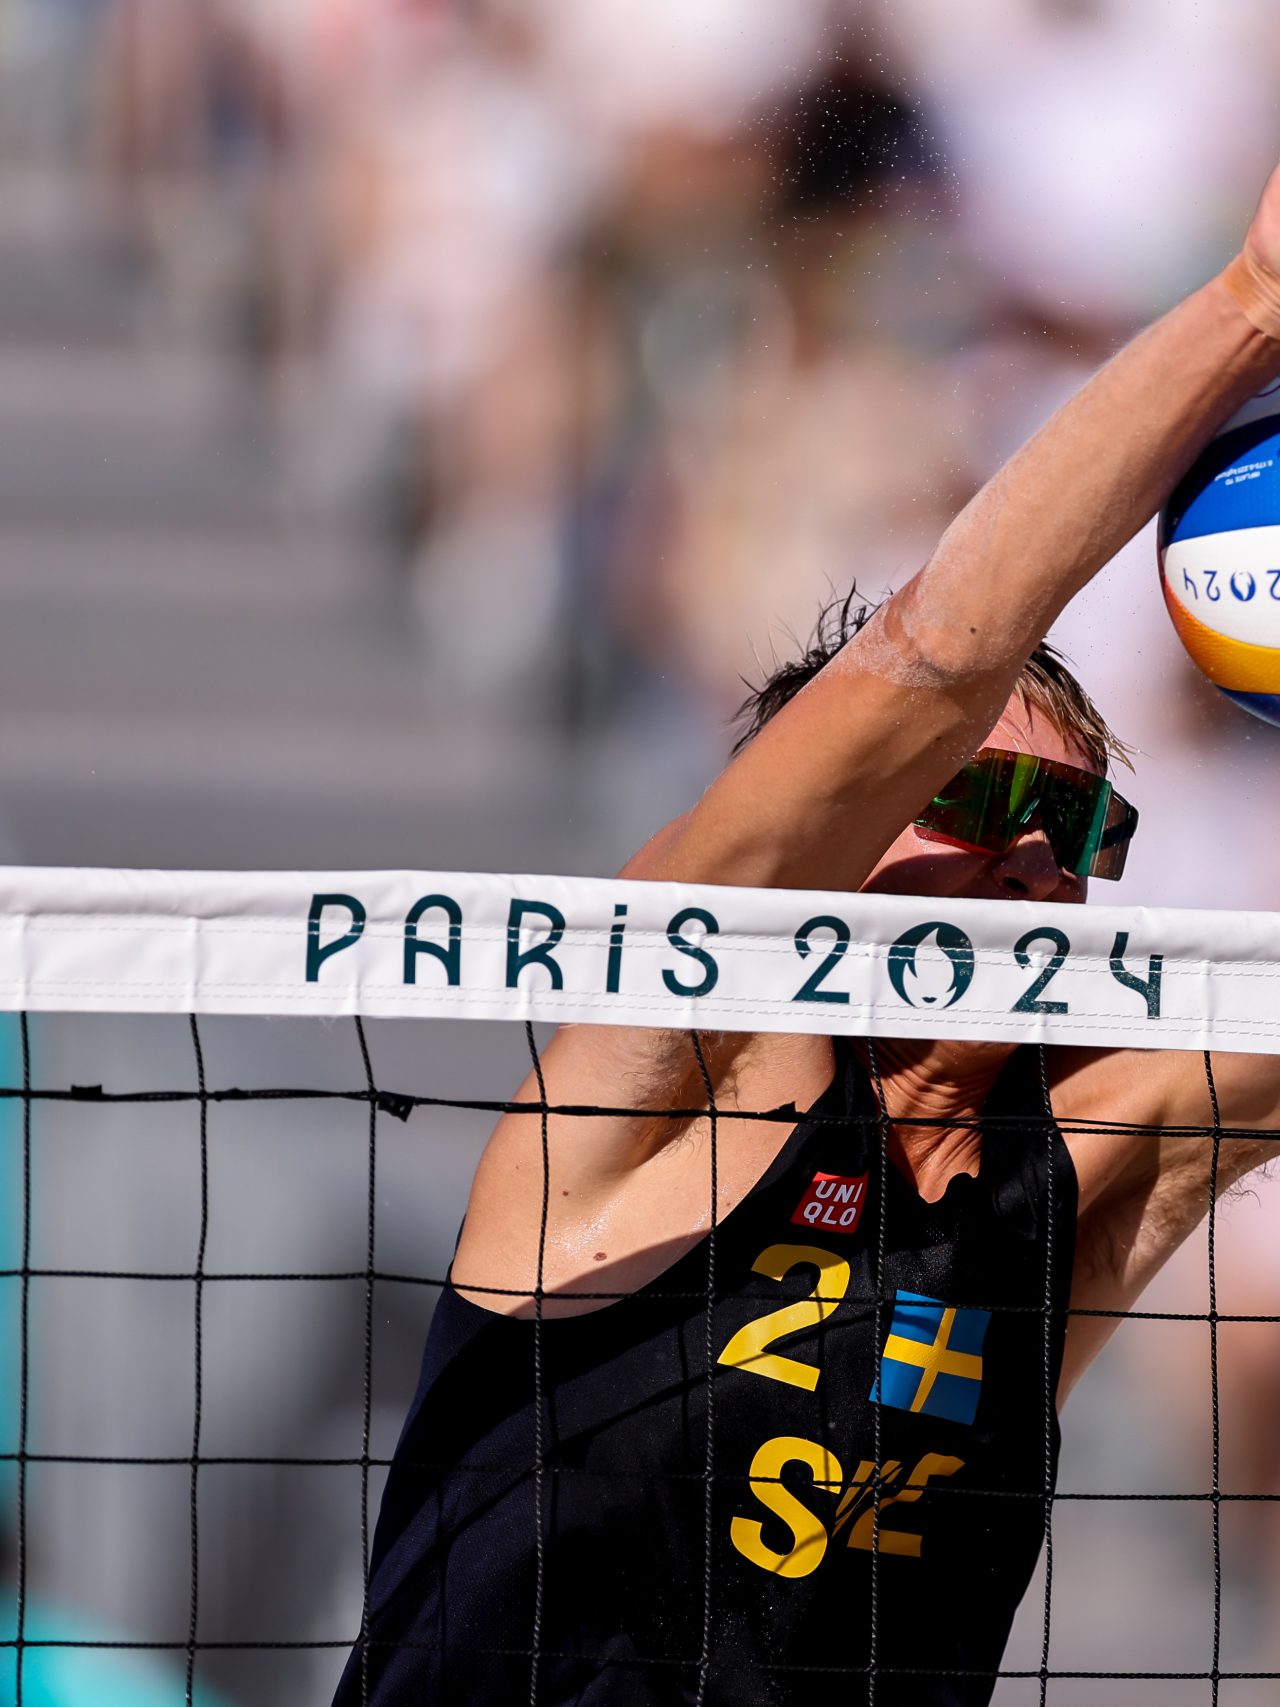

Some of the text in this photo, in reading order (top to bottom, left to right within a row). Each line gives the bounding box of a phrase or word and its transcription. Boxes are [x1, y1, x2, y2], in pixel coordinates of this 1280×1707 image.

[815, 1180, 863, 1203] UNI
[803, 1201, 857, 1226] QLO
[717, 1244, 851, 1392] 2
